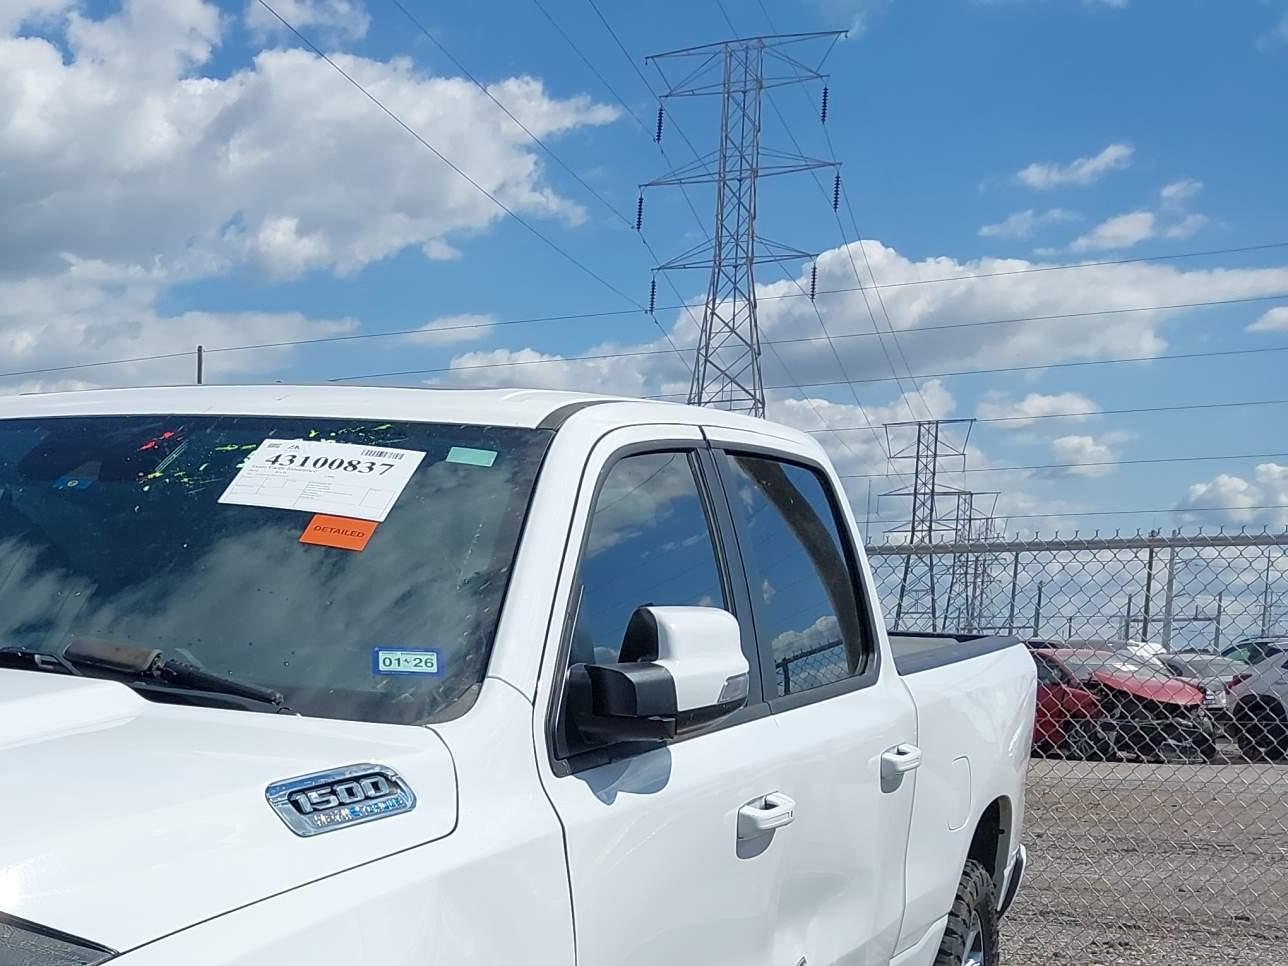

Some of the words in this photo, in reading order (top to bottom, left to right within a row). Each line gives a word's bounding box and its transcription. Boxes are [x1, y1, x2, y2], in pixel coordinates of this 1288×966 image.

[265, 453, 395, 477] 43100837
[313, 524, 365, 539] DETAILED
[382, 657, 401, 668] 01
[412, 657, 434, 669] 26
[289, 775, 389, 814] 1500
